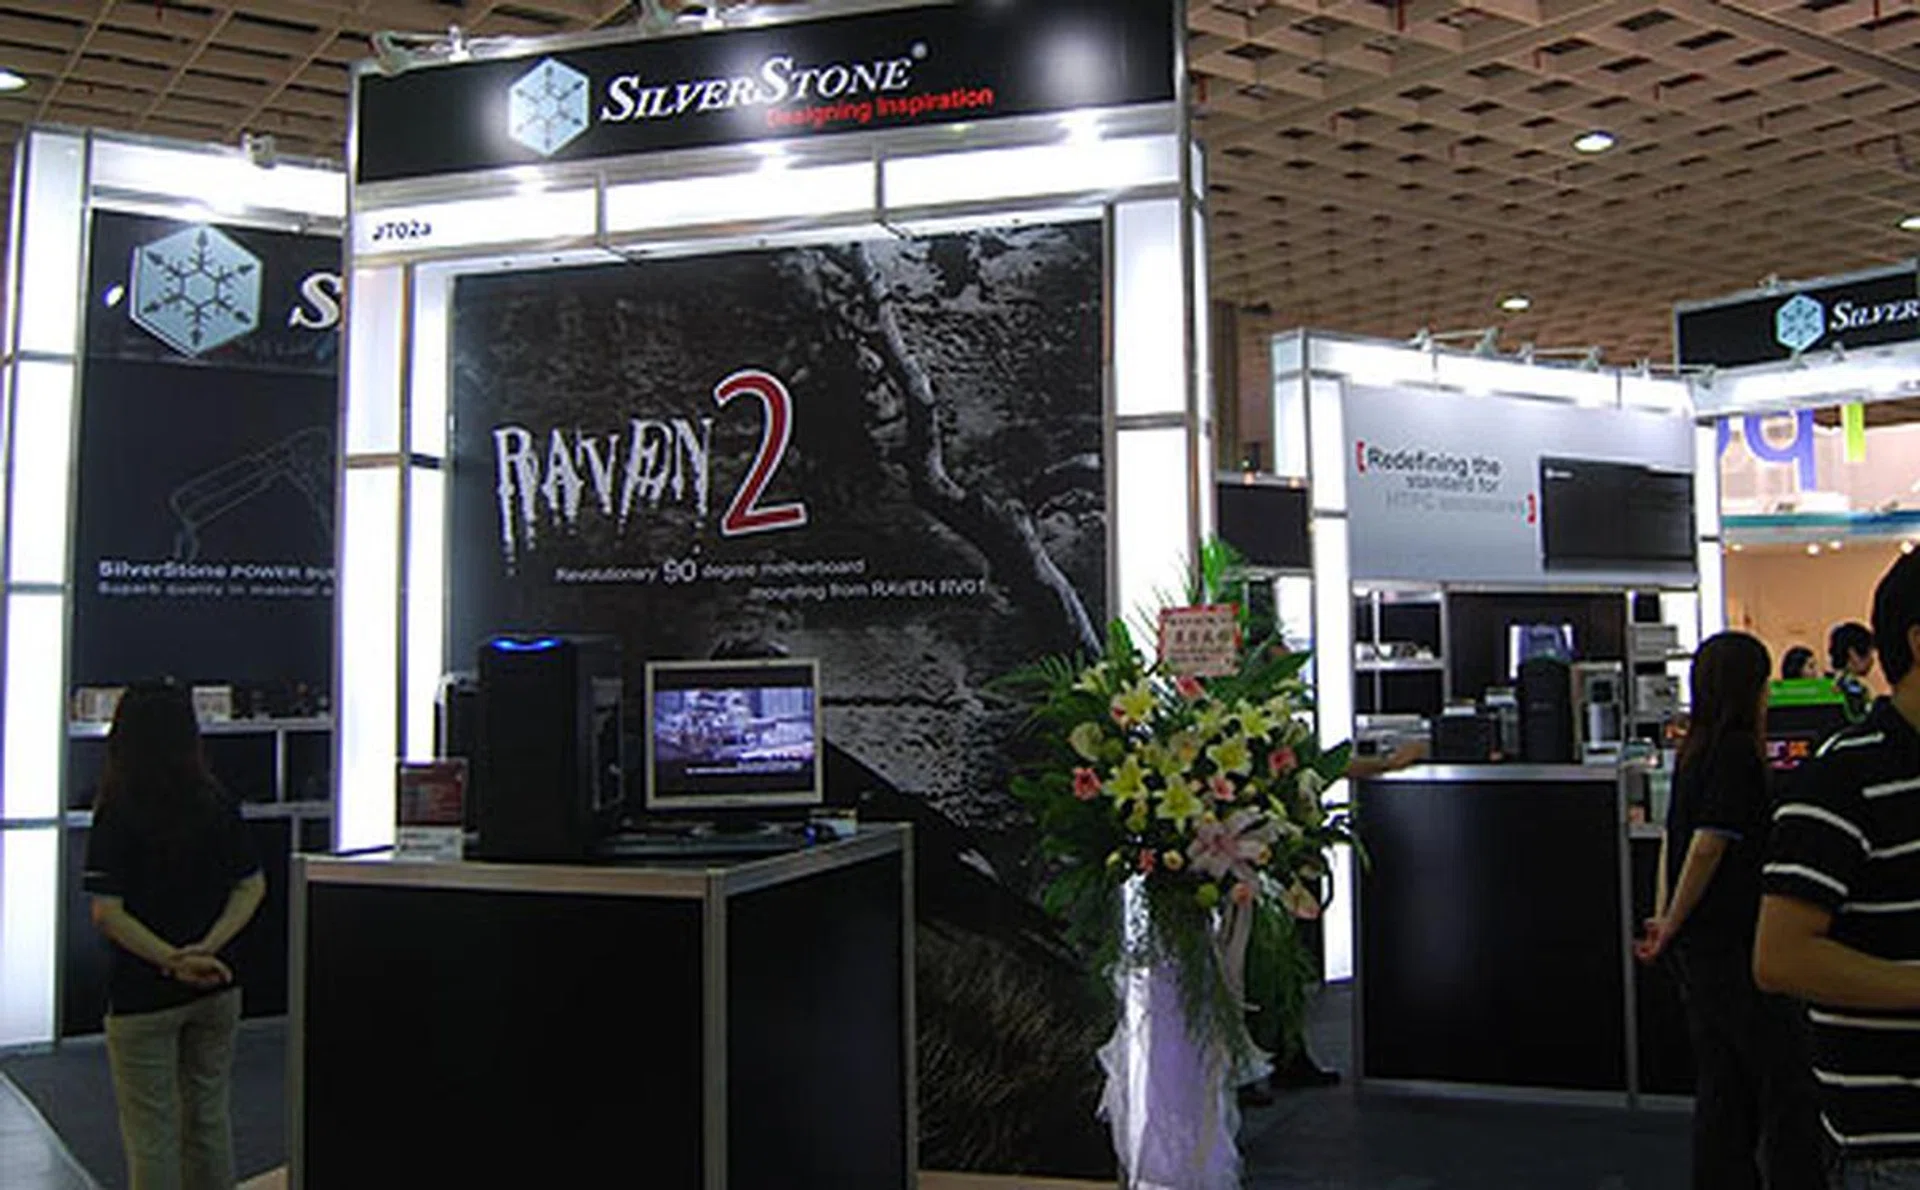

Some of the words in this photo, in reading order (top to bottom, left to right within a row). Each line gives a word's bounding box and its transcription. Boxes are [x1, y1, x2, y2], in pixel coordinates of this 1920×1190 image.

[877, 87, 994, 118] Inspiration
[714, 369, 807, 536] 2
[1367, 448, 1468, 477] Redefining
[1470, 457, 1501, 476] the
[1478, 476, 1499, 493] for
